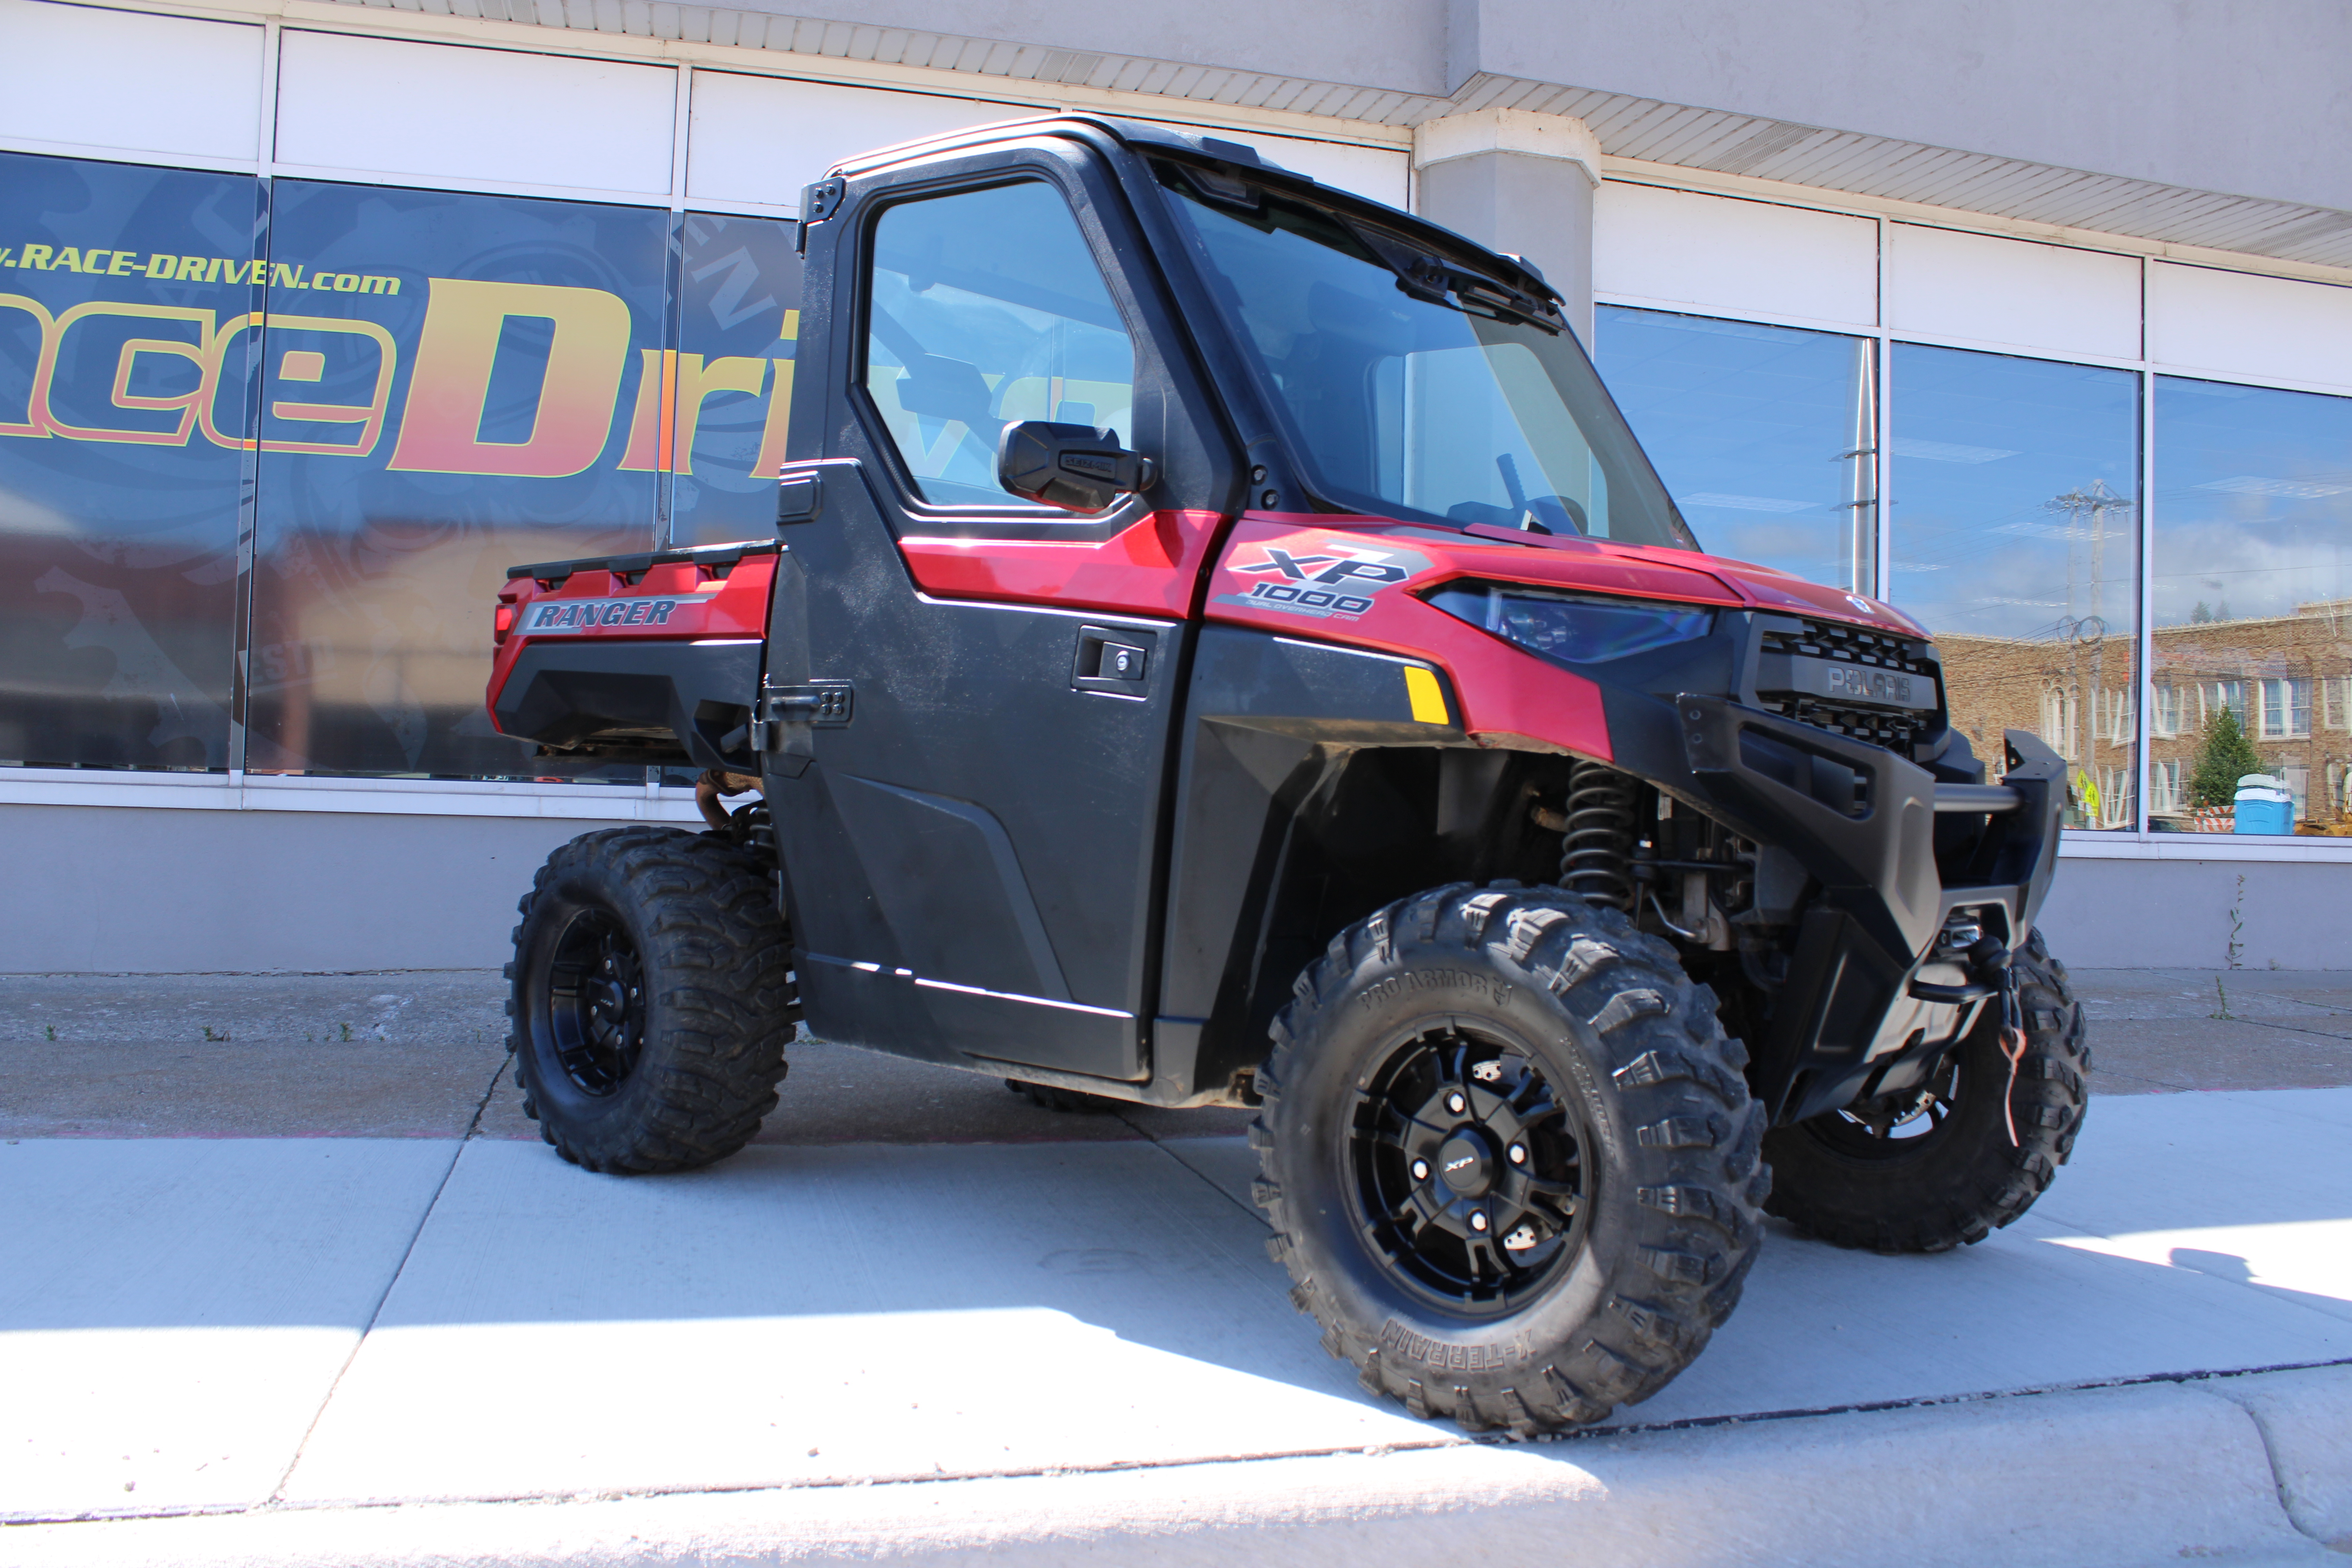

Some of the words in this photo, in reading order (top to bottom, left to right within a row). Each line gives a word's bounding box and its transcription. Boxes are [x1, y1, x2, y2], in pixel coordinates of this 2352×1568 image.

[0, 243, 401, 296] .RACE-DRIVEN.com
[1065, 456, 1112, 472] SEIZMIK
[1226, 546, 1410, 585] XP
[534, 600, 677, 628] RANGER
[1246, 599, 1272, 608] DUAL
[1274, 604, 1333, 617] OVERHEAD
[1333, 613, 1360, 622] CAM
[1250, 582, 1375, 615] 1000
[1828, 666, 1911, 702] POLARIS
[1356, 976, 1401, 1010] PRO
[1404, 968, 1488, 995] ARMOR
[1444, 1156, 1474, 1172] XP
[1381, 1317, 1537, 1370] X-TERRAIN
